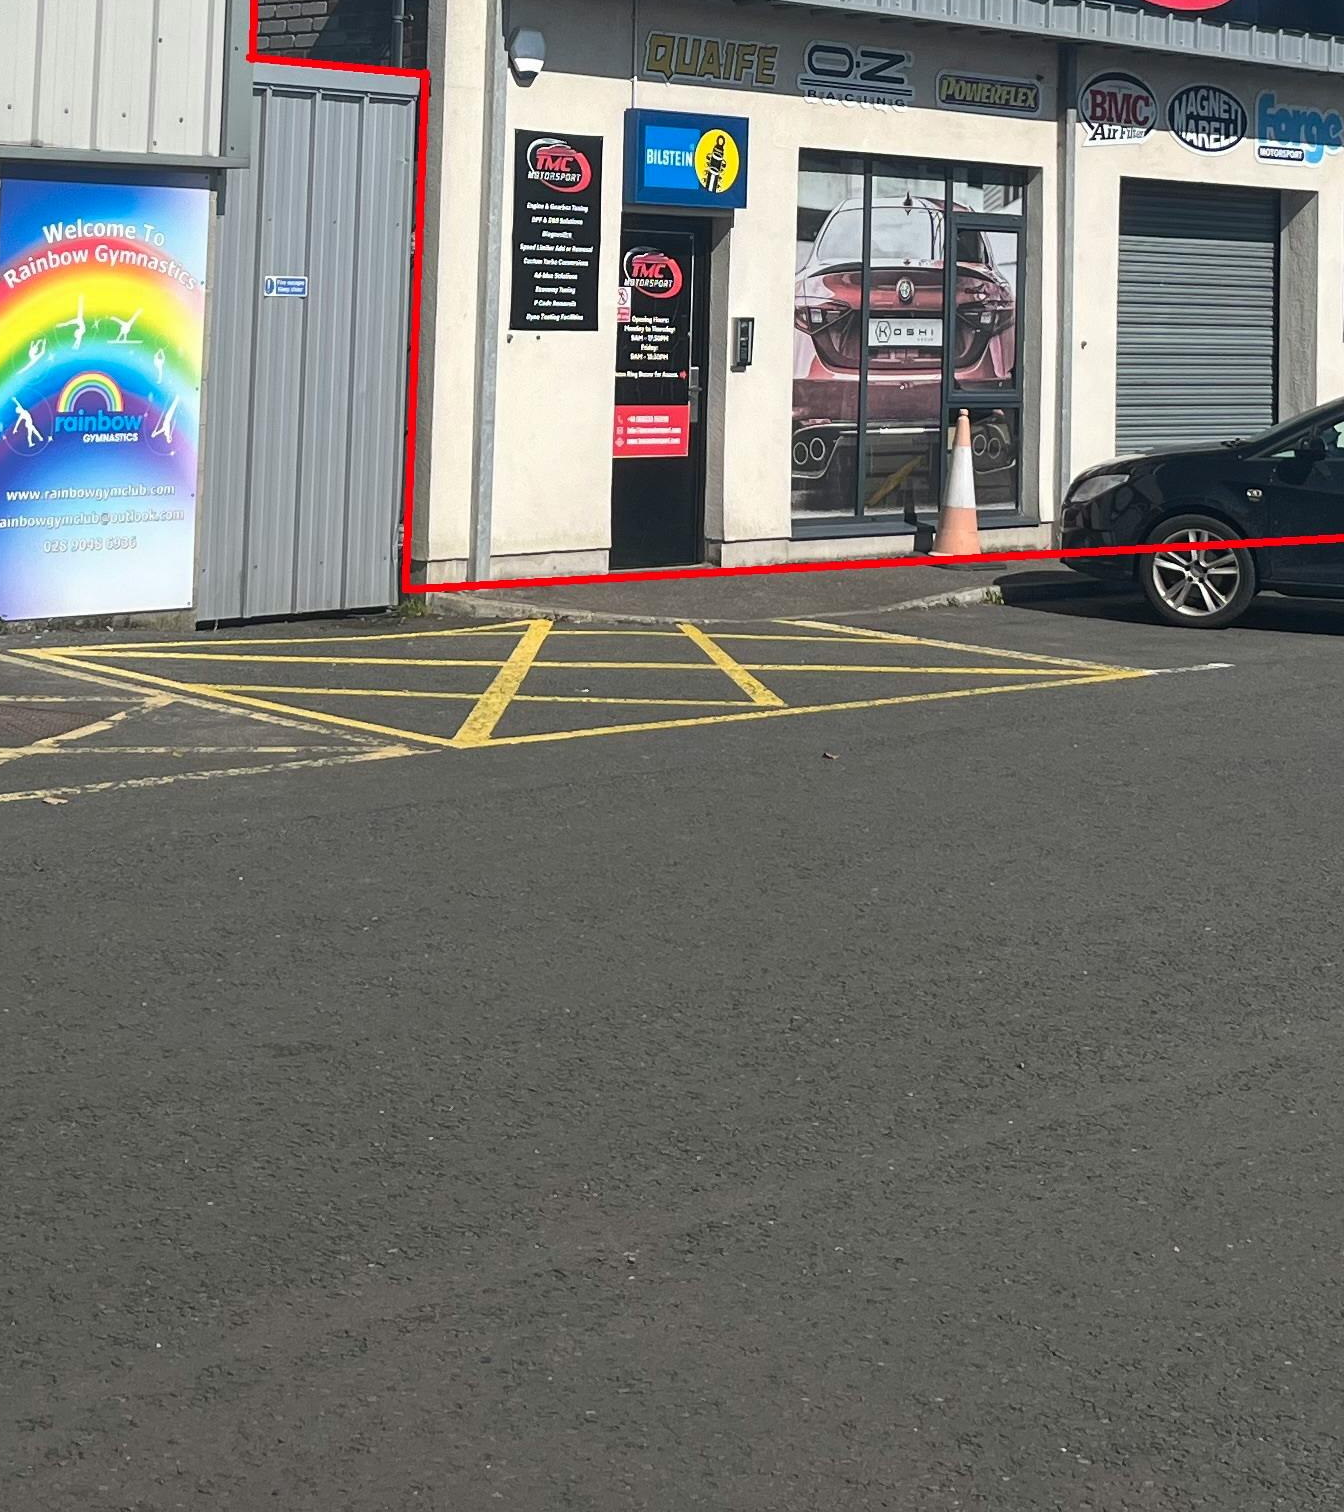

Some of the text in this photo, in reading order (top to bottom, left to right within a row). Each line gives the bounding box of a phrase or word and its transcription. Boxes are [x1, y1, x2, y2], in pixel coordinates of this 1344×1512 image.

[646, 34, 777, 83] QUAIFE
[807, 89, 905, 107] RACING
[940, 76, 1037, 109] POWERFLEX
[1089, 89, 1149, 126] BMC
[1174, 89, 1241, 126] MAGNETI
[536, 155, 574, 172] TMC
[647, 149, 693, 167] BILSTEIN
[527, 171, 581, 182] MOTORSPORT
[42, 219, 165, 246] Welcome To
[3, 245, 197, 290] Rainbow Gymnastics
[631, 262, 666, 279] TMC
[624, 278, 673, 288] MOTORSPORT
[55, 408, 143, 432] rainbow
[83, 433, 138, 443] GYMNASTICS
[6, 484, 175, 501] www.rainbowgymclub.com
